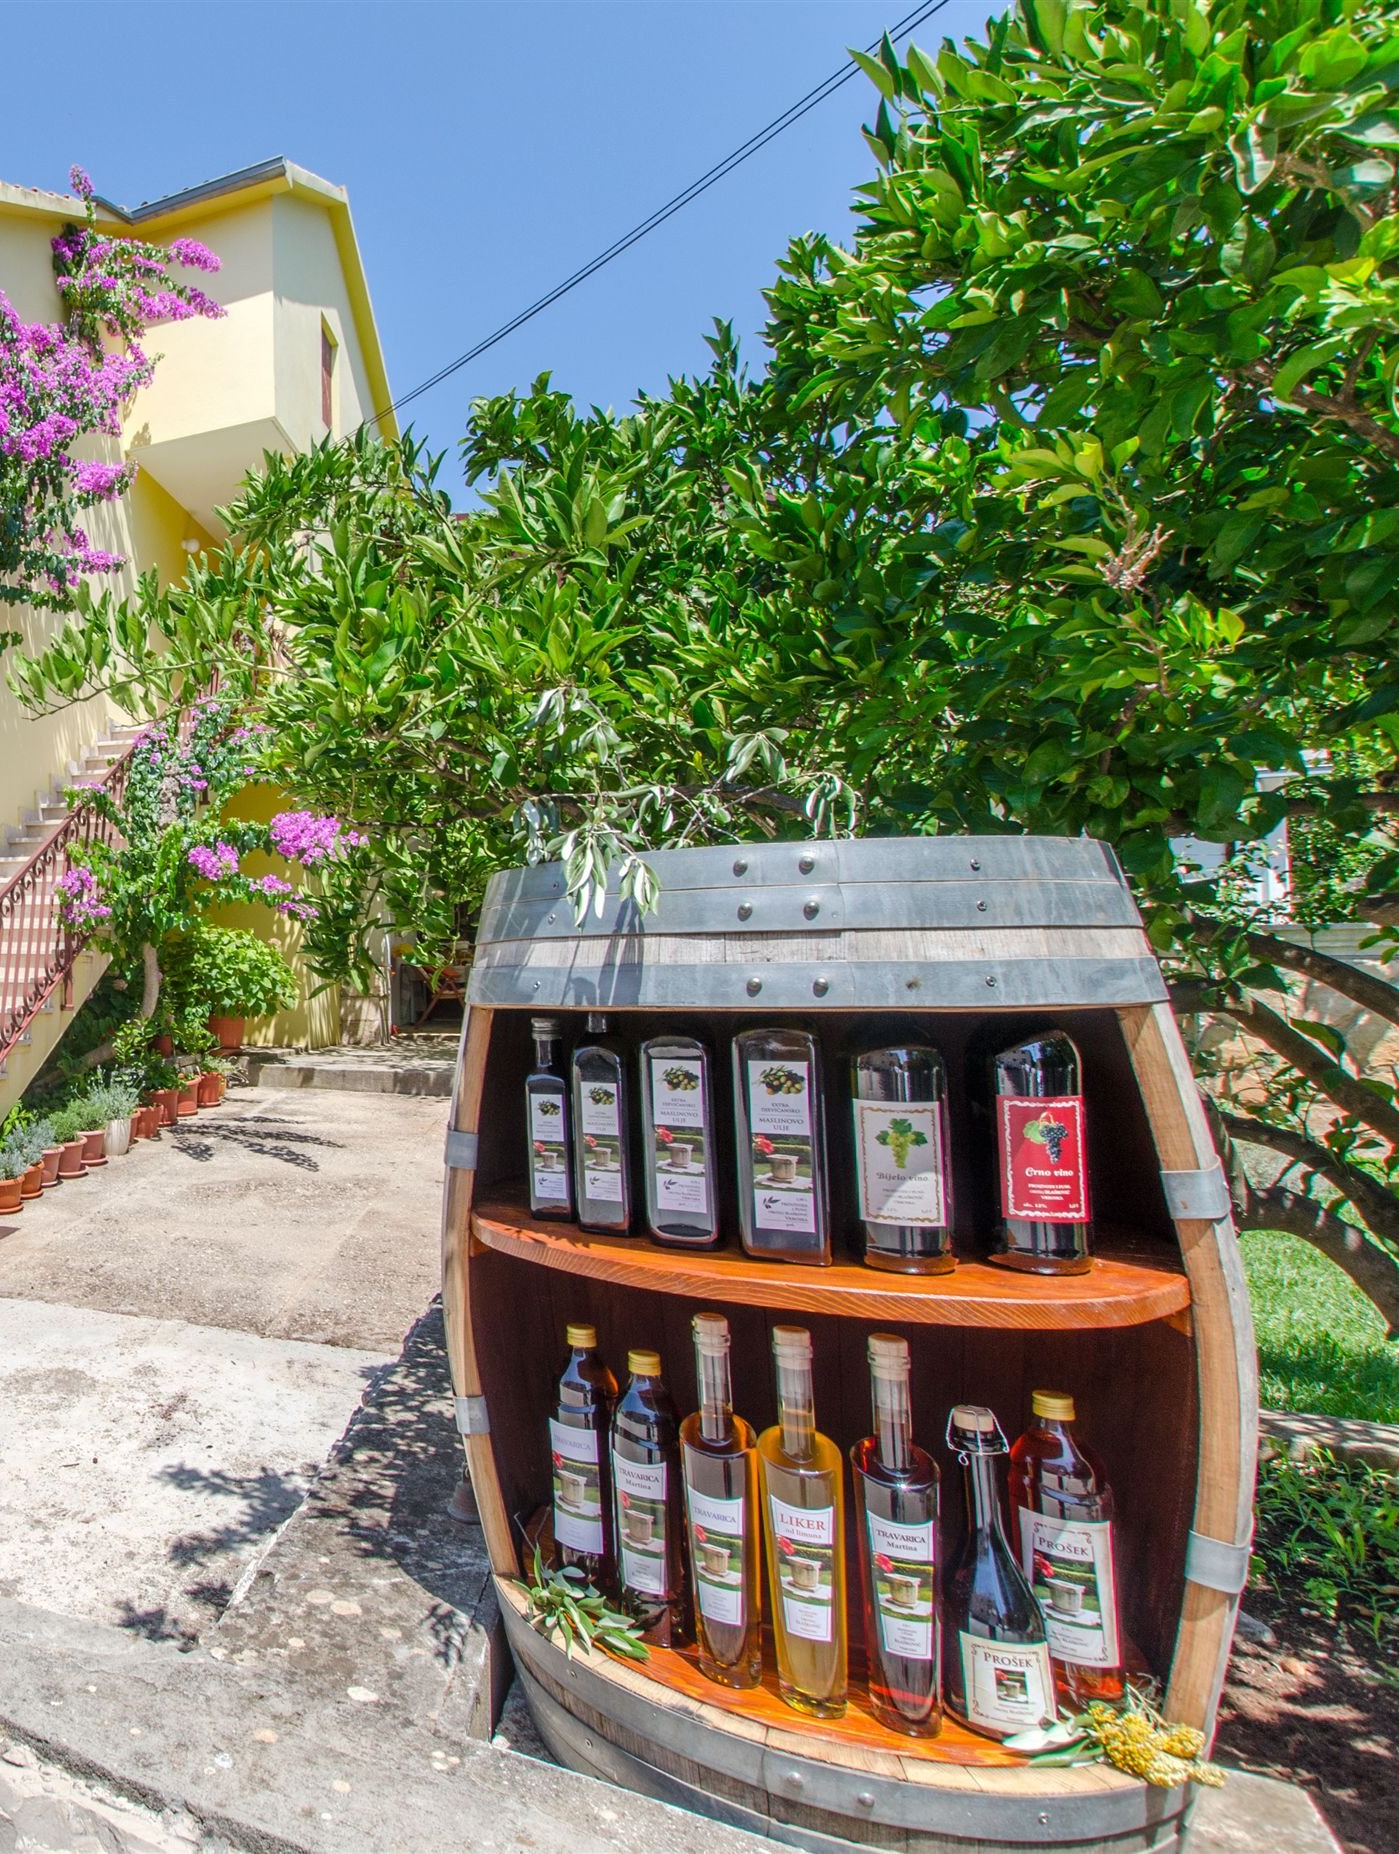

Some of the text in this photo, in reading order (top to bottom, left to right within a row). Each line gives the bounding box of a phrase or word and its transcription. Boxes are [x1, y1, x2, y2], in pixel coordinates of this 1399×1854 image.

[759, 1117, 805, 1125] MASLINOVO
[772, 1124, 790, 1132] ULJE
[875, 1172, 929, 1182] Bijelo vino
[1025, 1166, 1075, 1177] Crno vino
[618, 1466, 660, 1483] TRAVARICA
[694, 1506, 737, 1523] TRAVARICA
[780, 1513, 825, 1530] LIKER
[876, 1529, 927, 1544] TRAVARICA
[887, 1541, 918, 1552] Martina
[1038, 1536, 1089, 1557] PROŠEK
[983, 1651, 1034, 1668] PROŠEK
